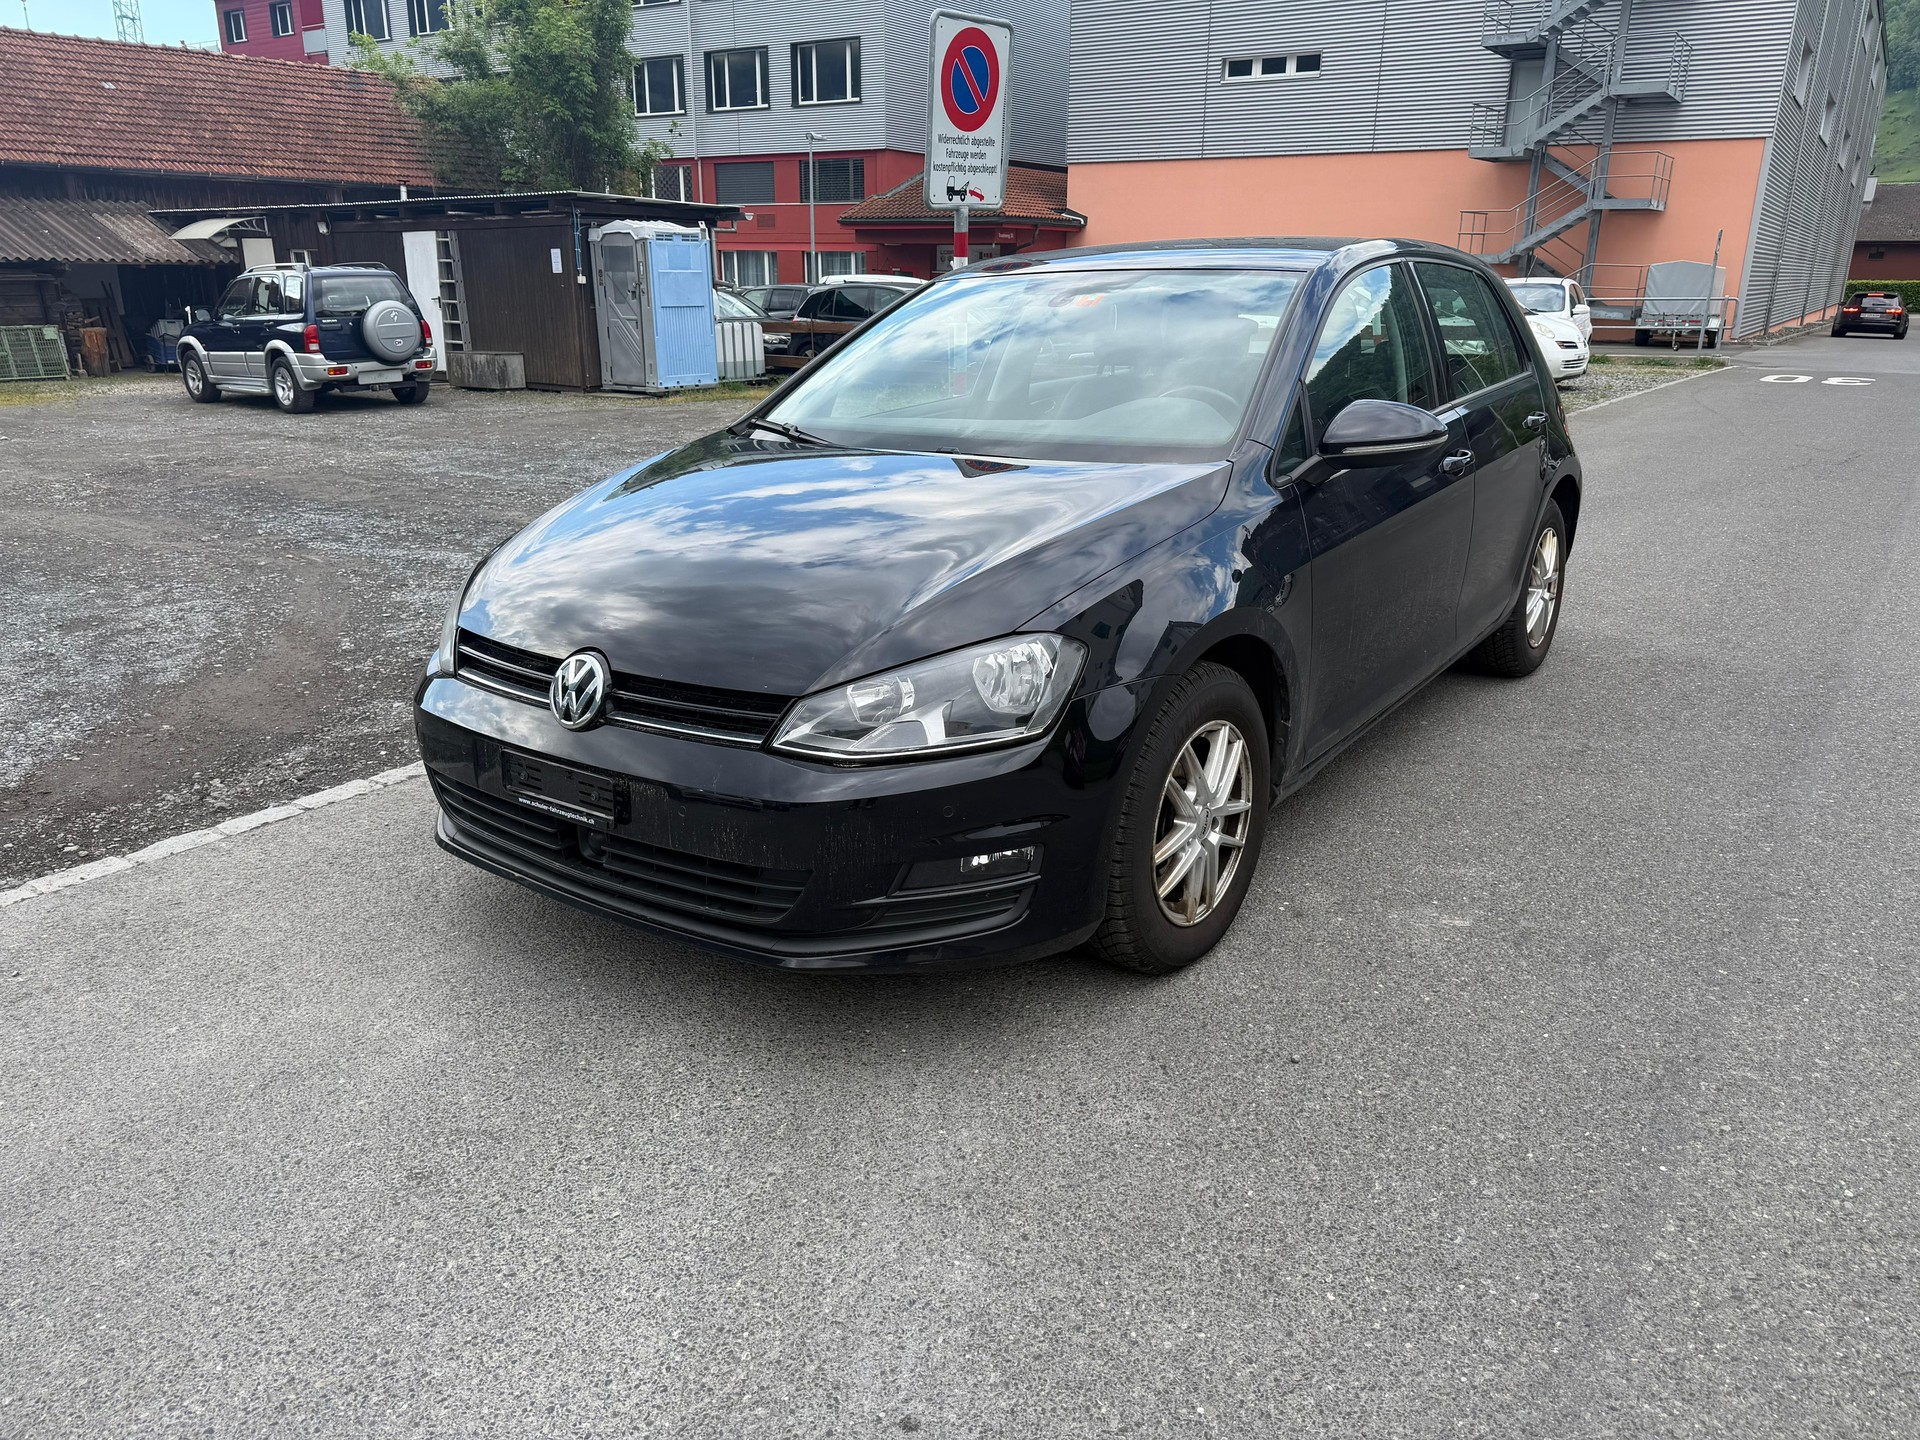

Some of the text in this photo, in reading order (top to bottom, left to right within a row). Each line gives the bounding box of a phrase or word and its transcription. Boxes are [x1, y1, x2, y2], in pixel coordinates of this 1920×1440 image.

[937, 133, 996, 149] Widerrechtlich abgestellte
[945, 148, 987, 161] Fahrzeuge werden
[933, 161, 998, 176] kostenpflichtig abgeschleppt!
[550, 654, 604, 728] VW
